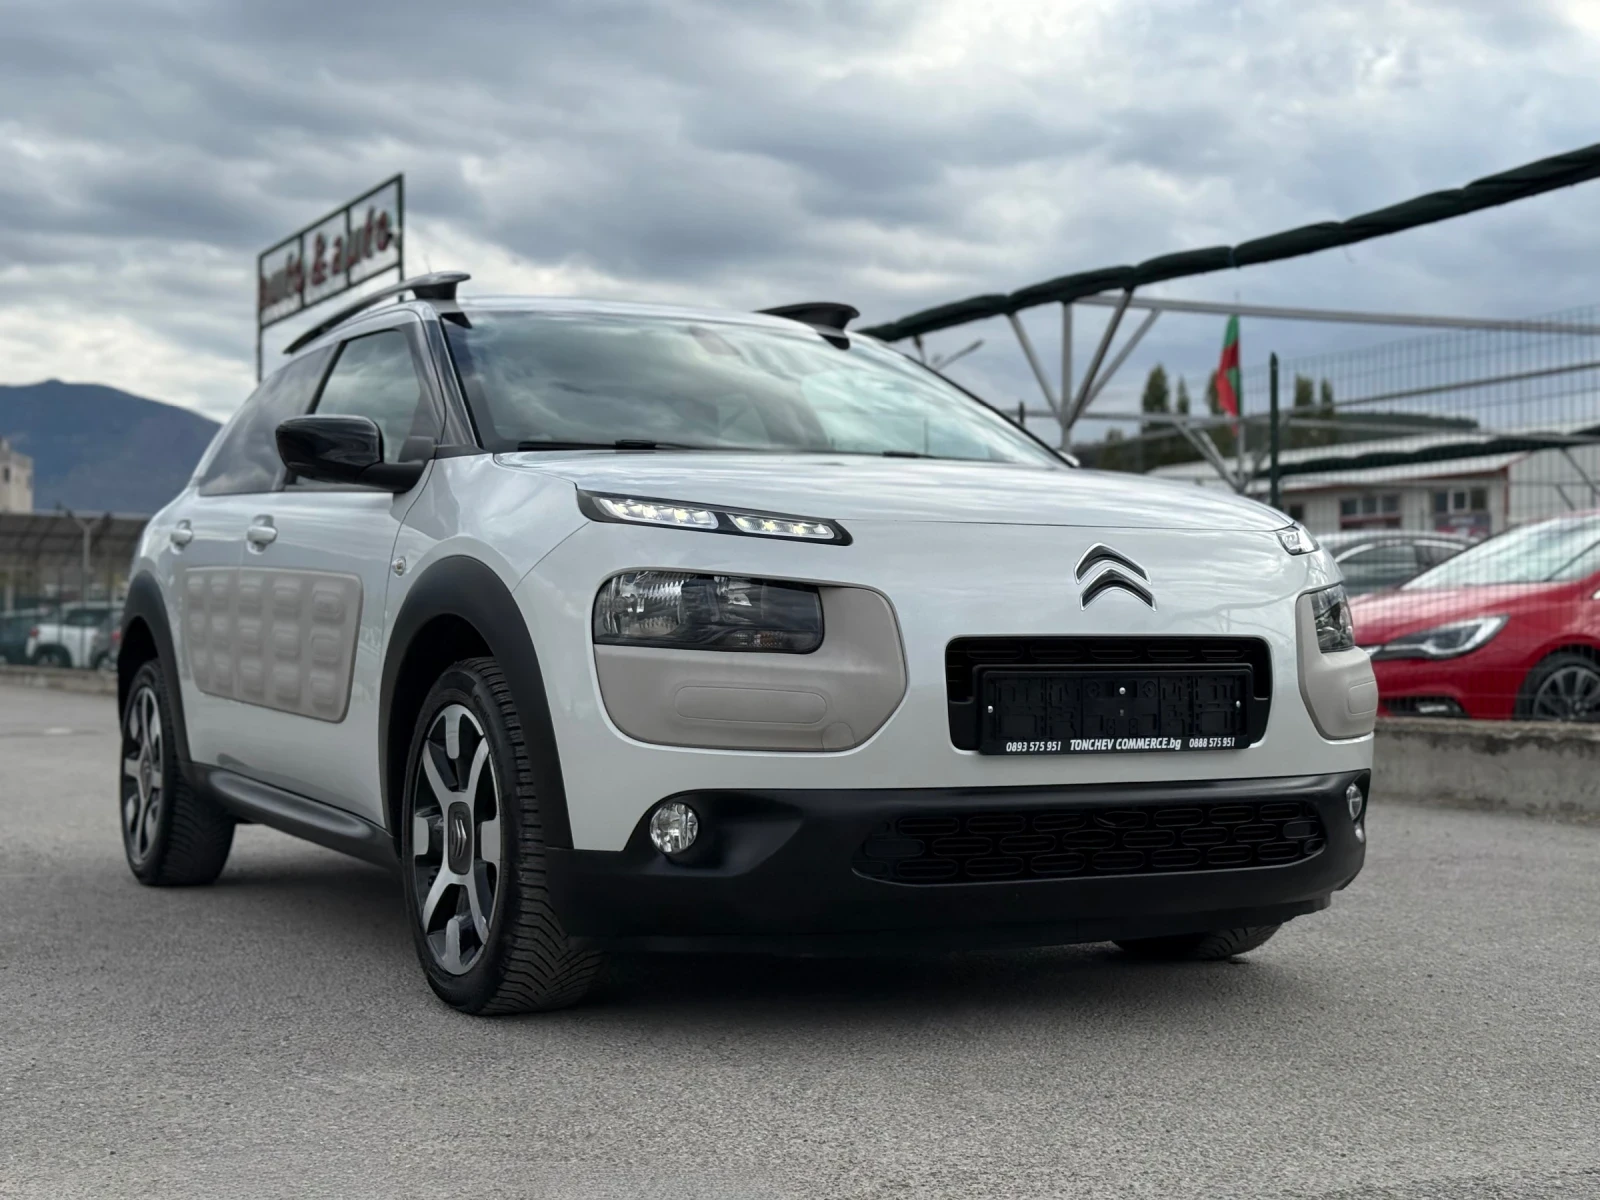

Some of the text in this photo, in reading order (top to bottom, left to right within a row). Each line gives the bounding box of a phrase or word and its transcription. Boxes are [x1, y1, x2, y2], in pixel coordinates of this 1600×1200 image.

[1006, 737, 1235, 752] 0893 575 951 TONCHEV COMMERCE.bg 0888 575 951
